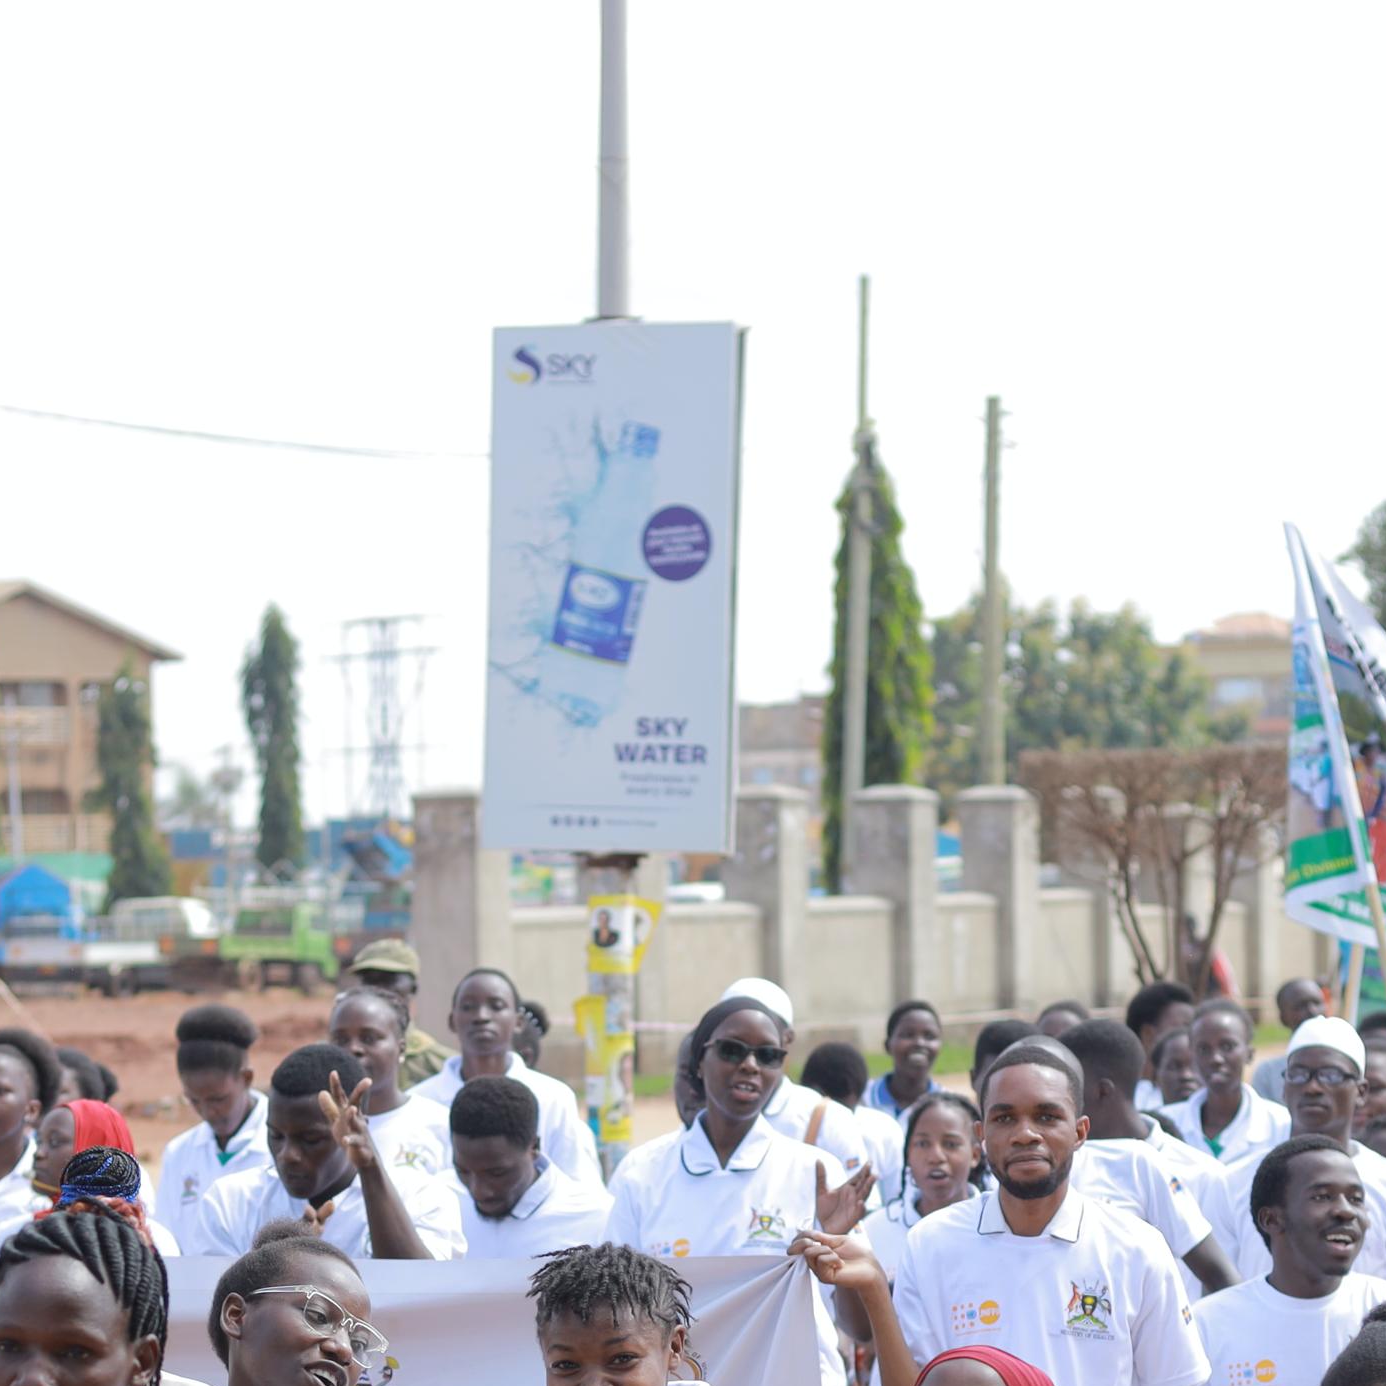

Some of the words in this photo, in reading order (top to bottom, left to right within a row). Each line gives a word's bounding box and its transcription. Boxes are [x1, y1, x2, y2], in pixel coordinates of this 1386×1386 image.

[546, 352, 597, 378] SKY
[636, 716, 689, 737] SKY
[614, 743, 709, 764] WATER
